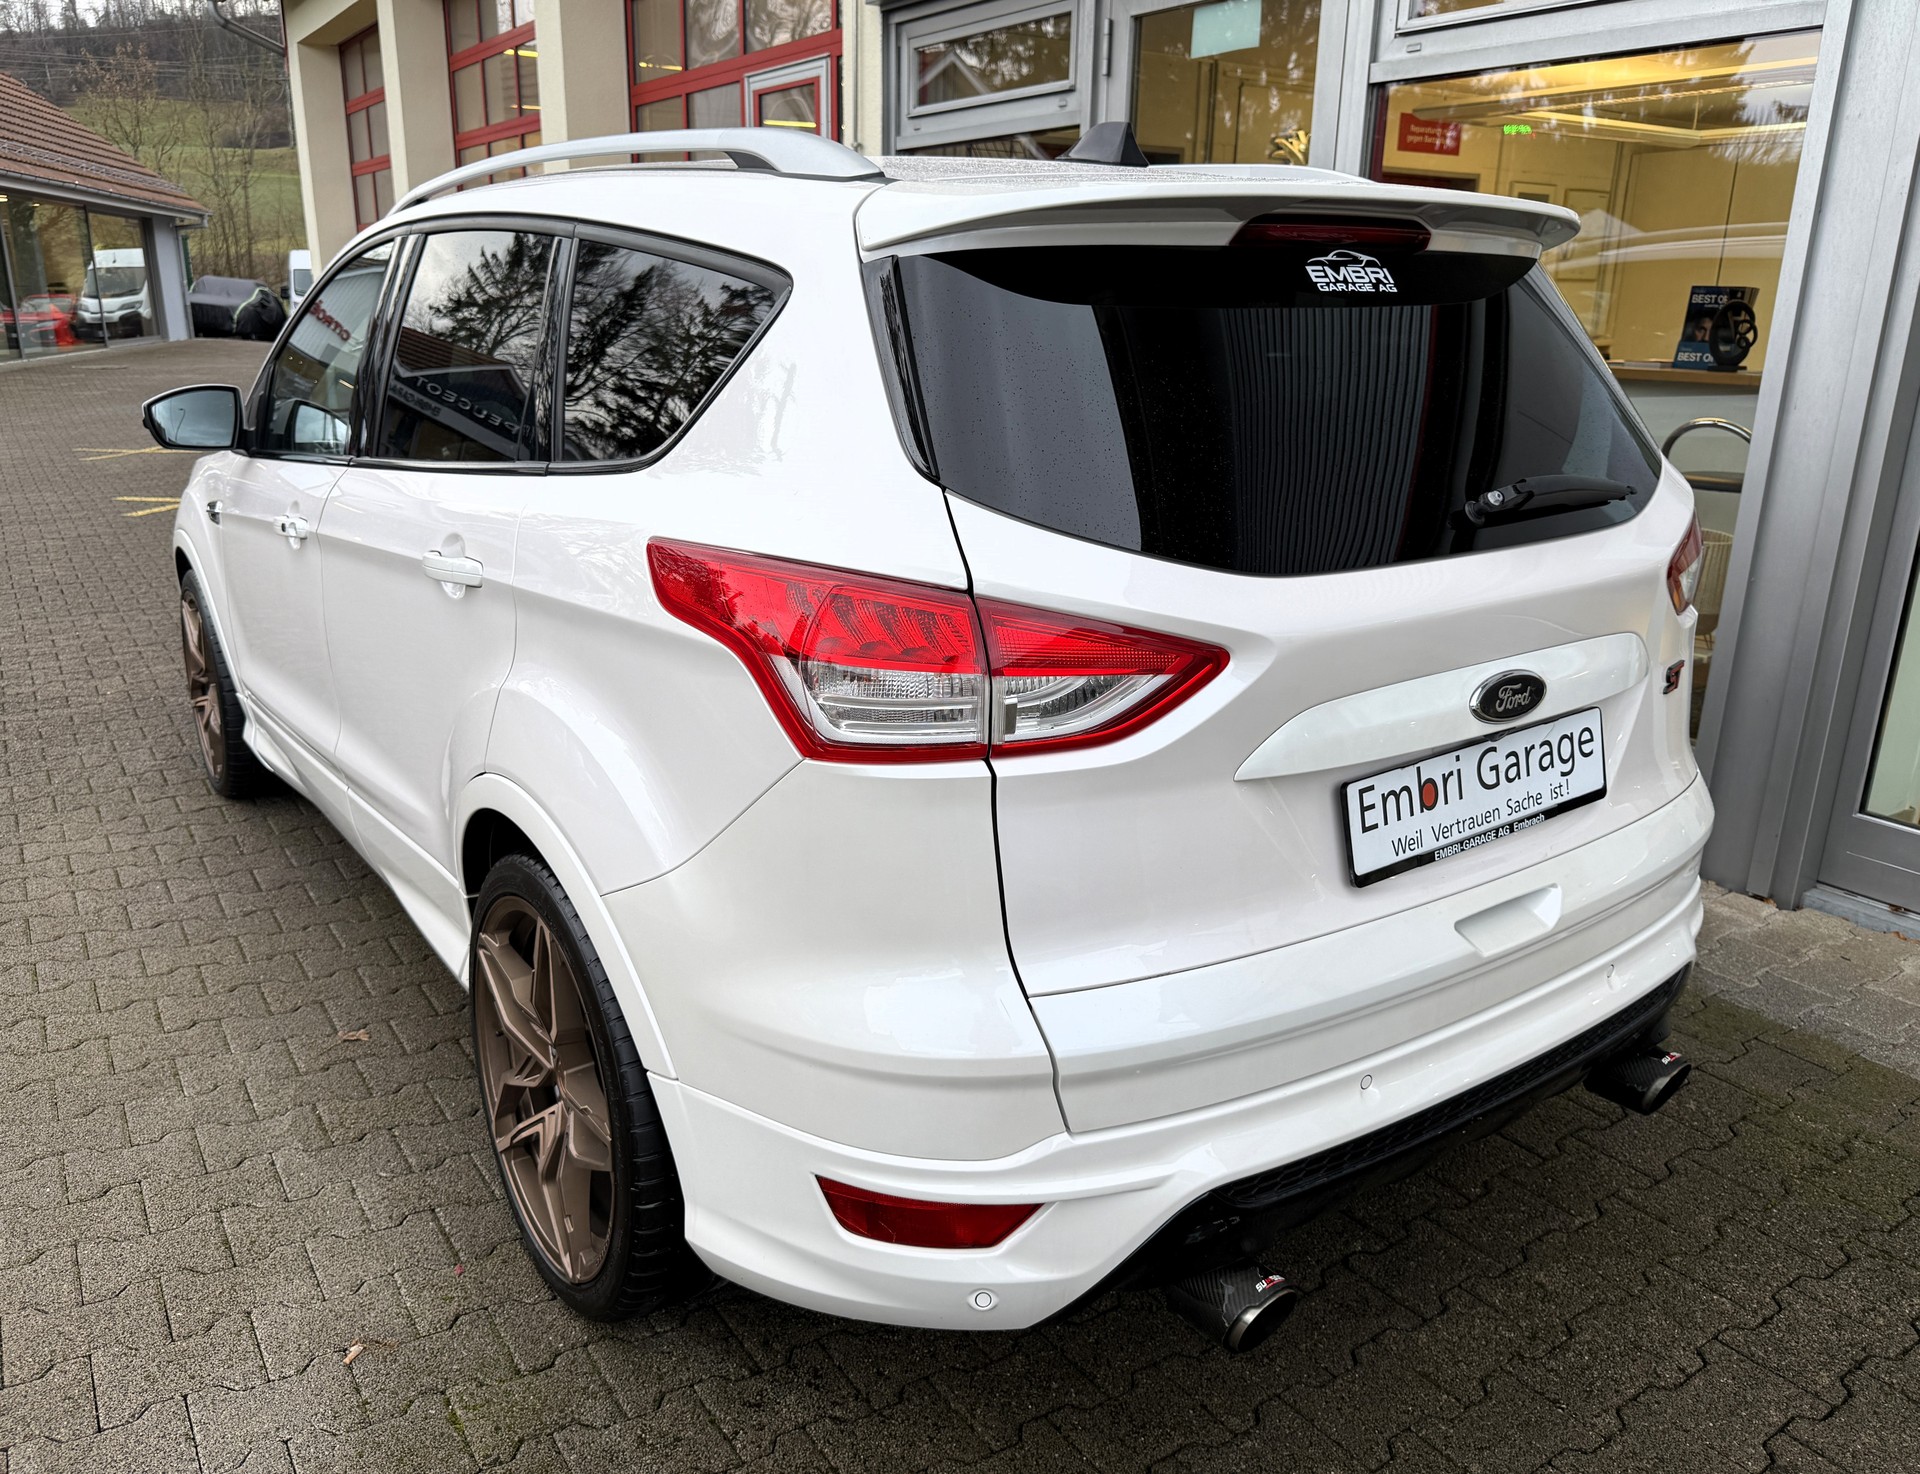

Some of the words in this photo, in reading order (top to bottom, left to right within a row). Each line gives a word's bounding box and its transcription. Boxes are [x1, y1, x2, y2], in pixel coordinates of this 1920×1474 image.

[1305, 265, 1395, 284] EMBRI
[1316, 283, 1376, 292] GARAGE
[1379, 284, 1398, 293] AG
[1691, 293, 1718, 304] BEST
[1677, 351, 1702, 362] BEST
[1495, 683, 1532, 712] Ford
[1358, 755, 1463, 833] Embri
[1476, 725, 1594, 791] Garage
[1391, 828, 1424, 857] Weil
[1431, 806, 1501, 843] Vertrauen
[1506, 790, 1543, 816] Sache
[1434, 829, 1497, 861] EMBRI-GARAGE
[1497, 825, 1510, 840] AG
[1513, 813, 1545, 833] Embrach
